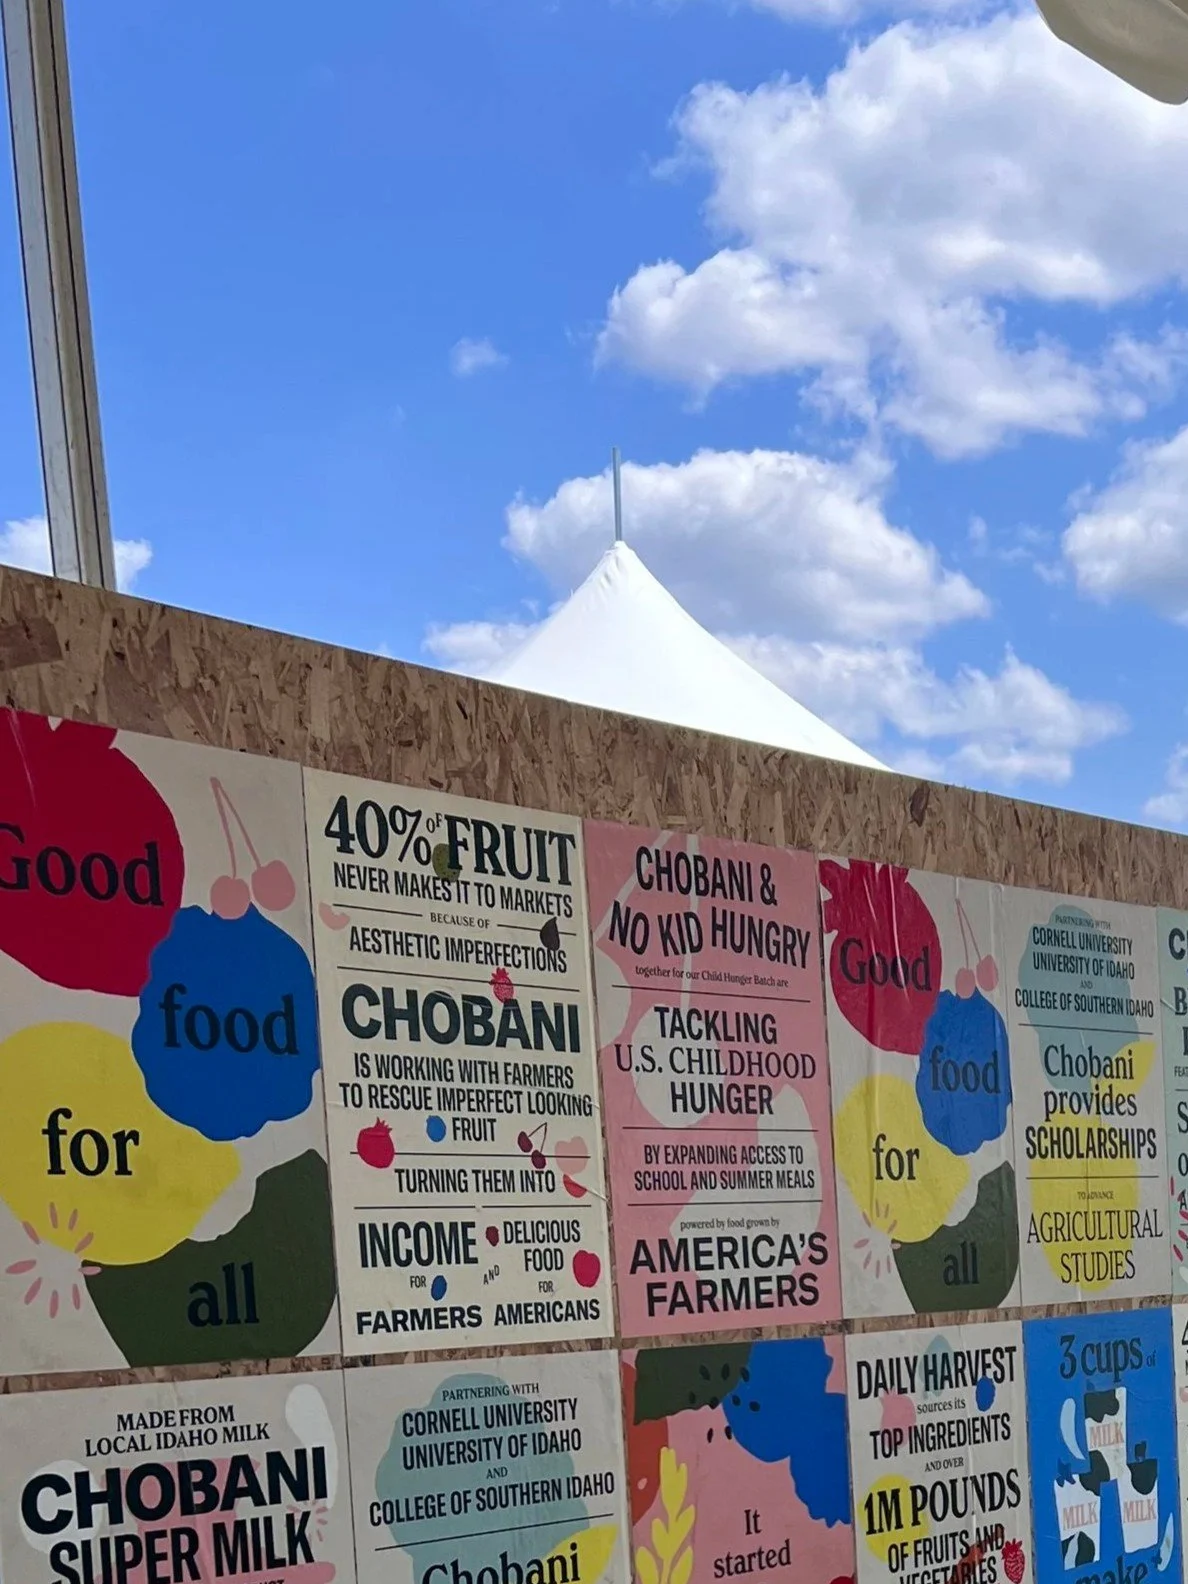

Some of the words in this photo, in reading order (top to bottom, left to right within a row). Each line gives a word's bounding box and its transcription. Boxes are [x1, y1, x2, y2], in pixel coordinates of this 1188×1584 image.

[325, 795, 432, 866] 40%
[426, 812, 443, 834] OF
[444, 814, 576, 886] FRUIT
[333, 862, 390, 894] NEVER
[394, 872, 451, 901] MAKES
[456, 881, 471, 904] IT
[474, 882, 496, 909] TO
[500, 886, 573, 918] MARKETS
[635, 846, 754, 903] CHOBANI
[760, 862, 778, 906] &
[430, 912, 476, 929] BECAUSE
[478, 918, 491, 929] OF
[608, 899, 650, 956] NO
[657, 911, 703, 957] KID
[711, 906, 811, 969] HUNGRY
[349, 926, 440, 961] AESTHETIC
[444, 937, 567, 974] IMPERFECTIONS
[839, 937, 933, 992] Good
[635, 965, 671, 979] together
[673, 967, 684, 979] for
[685, 971, 700, 980] our
[702, 970, 723, 982] Child
[724, 972, 752, 987] Hunger
[754, 975, 776, 987] Batch
[777, 978, 789, 988] are
[160, 983, 299, 1057] food
[341, 983, 581, 1053] CHOBANI
[653, 1006, 778, 1045] TACKLING
[354, 1052, 371, 1078] IS
[374, 1054, 454, 1083] WORKING
[457, 1059, 500, 1085] WITH
[503, 1062, 574, 1089] FARMERS
[614, 1043, 663, 1074] U.S.
[669, 1046, 816, 1079] CHILDHOOD
[929, 1045, 1002, 1095] food
[1044, 1042, 1135, 1081] Chobani
[339, 1082, 363, 1109] TO
[369, 1084, 433, 1112] RESCUE
[437, 1087, 524, 1114] IMPERFECT
[527, 1091, 593, 1117] LOOKING
[670, 1081, 774, 1115] HUNGER
[1043, 1083, 1138, 1123] provides
[42, 1108, 140, 1176] for
[452, 1117, 497, 1142] FRUIT
[1025, 1125, 1158, 1161] SCHOLARSHIPS
[872, 1132, 921, 1182] for
[394, 1168, 469, 1193] TURNING
[471, 1169, 516, 1193] THEM
[520, 1169, 556, 1193] INTO
[358, 1221, 479, 1268] INCOME
[503, 1219, 581, 1245] DELICIOUS
[1026, 1208, 1164, 1244] AGRICULTURAL
[524, 1248, 564, 1272] FOOD
[629, 1232, 829, 1275] AMERICA'S
[943, 1240, 980, 1287] all
[1060, 1248, 1136, 1285] STUDIES
[187, 1261, 261, 1327] all
[494, 1298, 601, 1327] AMERICANS
[646, 1272, 820, 1317] FARMERS
[356, 1305, 483, 1335] FARMERS
[857, 1355, 918, 1400] DAILY
[1059, 1334, 1078, 1380] 3
[1081, 1336, 1144, 1384] cups
[1146, 1350, 1157, 1369] of
[116, 1408, 177, 1432] MADE
[179, 1405, 236, 1428] FROM
[870, 1428, 903, 1460] TOP
[908, 1412, 1011, 1455] INGREDIENTS
[1089, 1421, 1126, 1450] MILK
[84, 1435, 152, 1458] LOCAL
[155, 1427, 219, 1452] IDAHO
[222, 1422, 271, 1443] MILK
[20, 1446, 328, 1536] CHOBANI
[864, 1488, 903, 1535] 1M
[910, 1468, 1021, 1527] POUNDS
[1123, 1498, 1157, 1524] MILK
[743, 1508, 761, 1537] It
[1062, 1501, 1098, 1531] MILK
[212, 1511, 315, 1578] MILK
[713, 1538, 792, 1579] started
